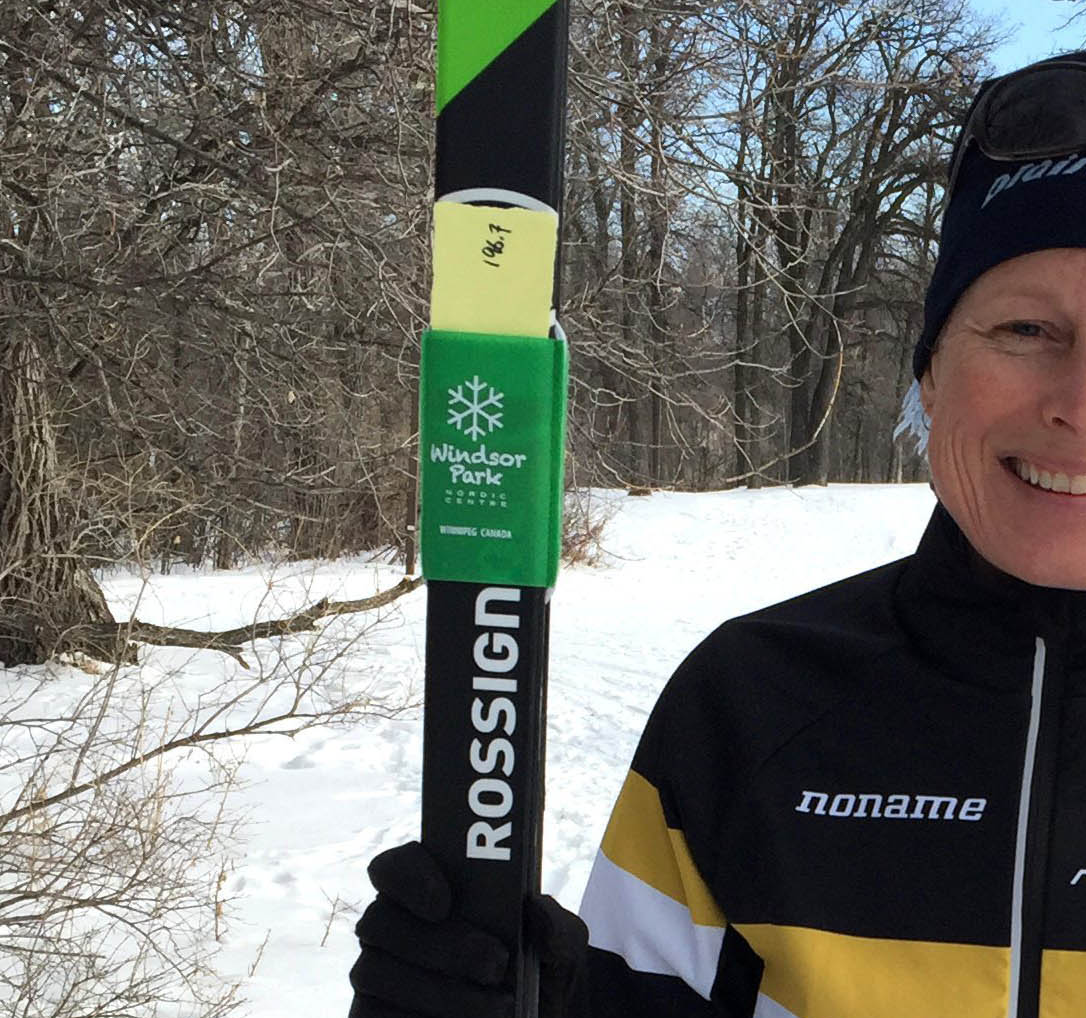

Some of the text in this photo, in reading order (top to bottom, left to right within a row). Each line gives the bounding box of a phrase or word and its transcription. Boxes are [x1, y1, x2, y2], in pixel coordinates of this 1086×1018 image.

[430, 443, 527, 468] Windsor
[449, 464, 503, 485] Park
[480, 528, 512, 539] CANADA
[795, 790, 987, 822] noname
